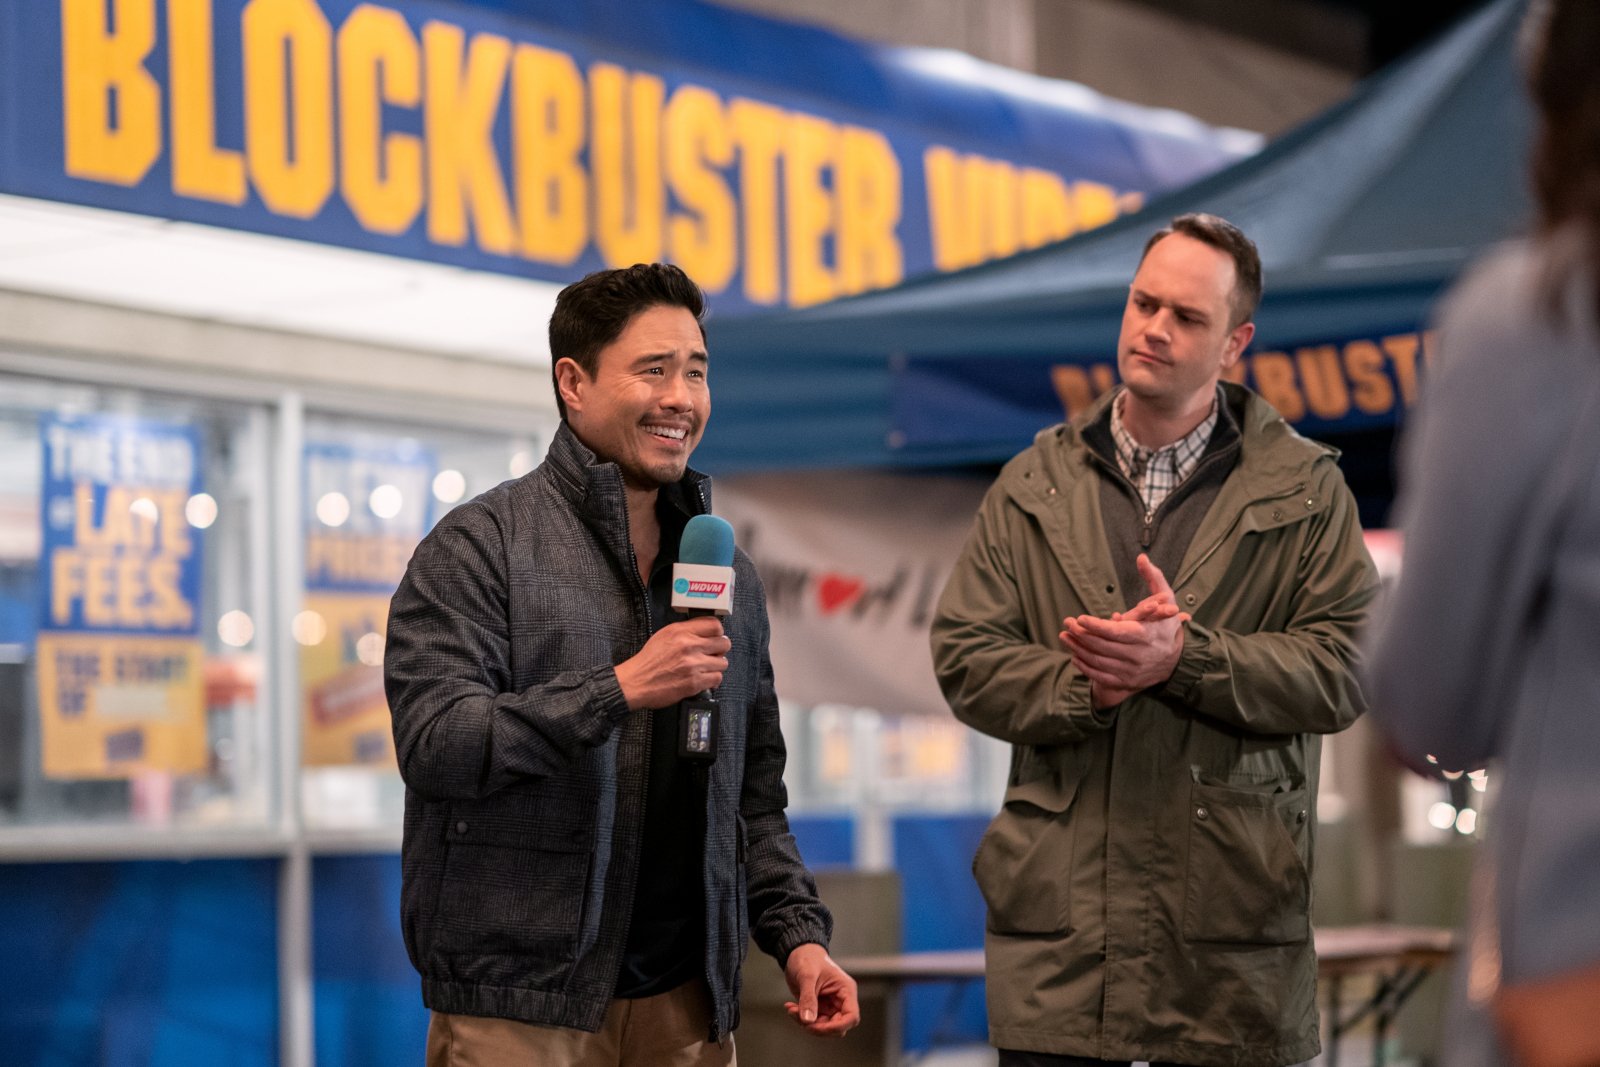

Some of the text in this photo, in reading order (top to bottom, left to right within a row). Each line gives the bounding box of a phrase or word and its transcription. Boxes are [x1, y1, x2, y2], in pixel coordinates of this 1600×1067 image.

[61, 0, 904, 308] BLOCKBUSTER
[75, 479, 192, 558] LATE
[690, 582, 723, 592] WDVM
